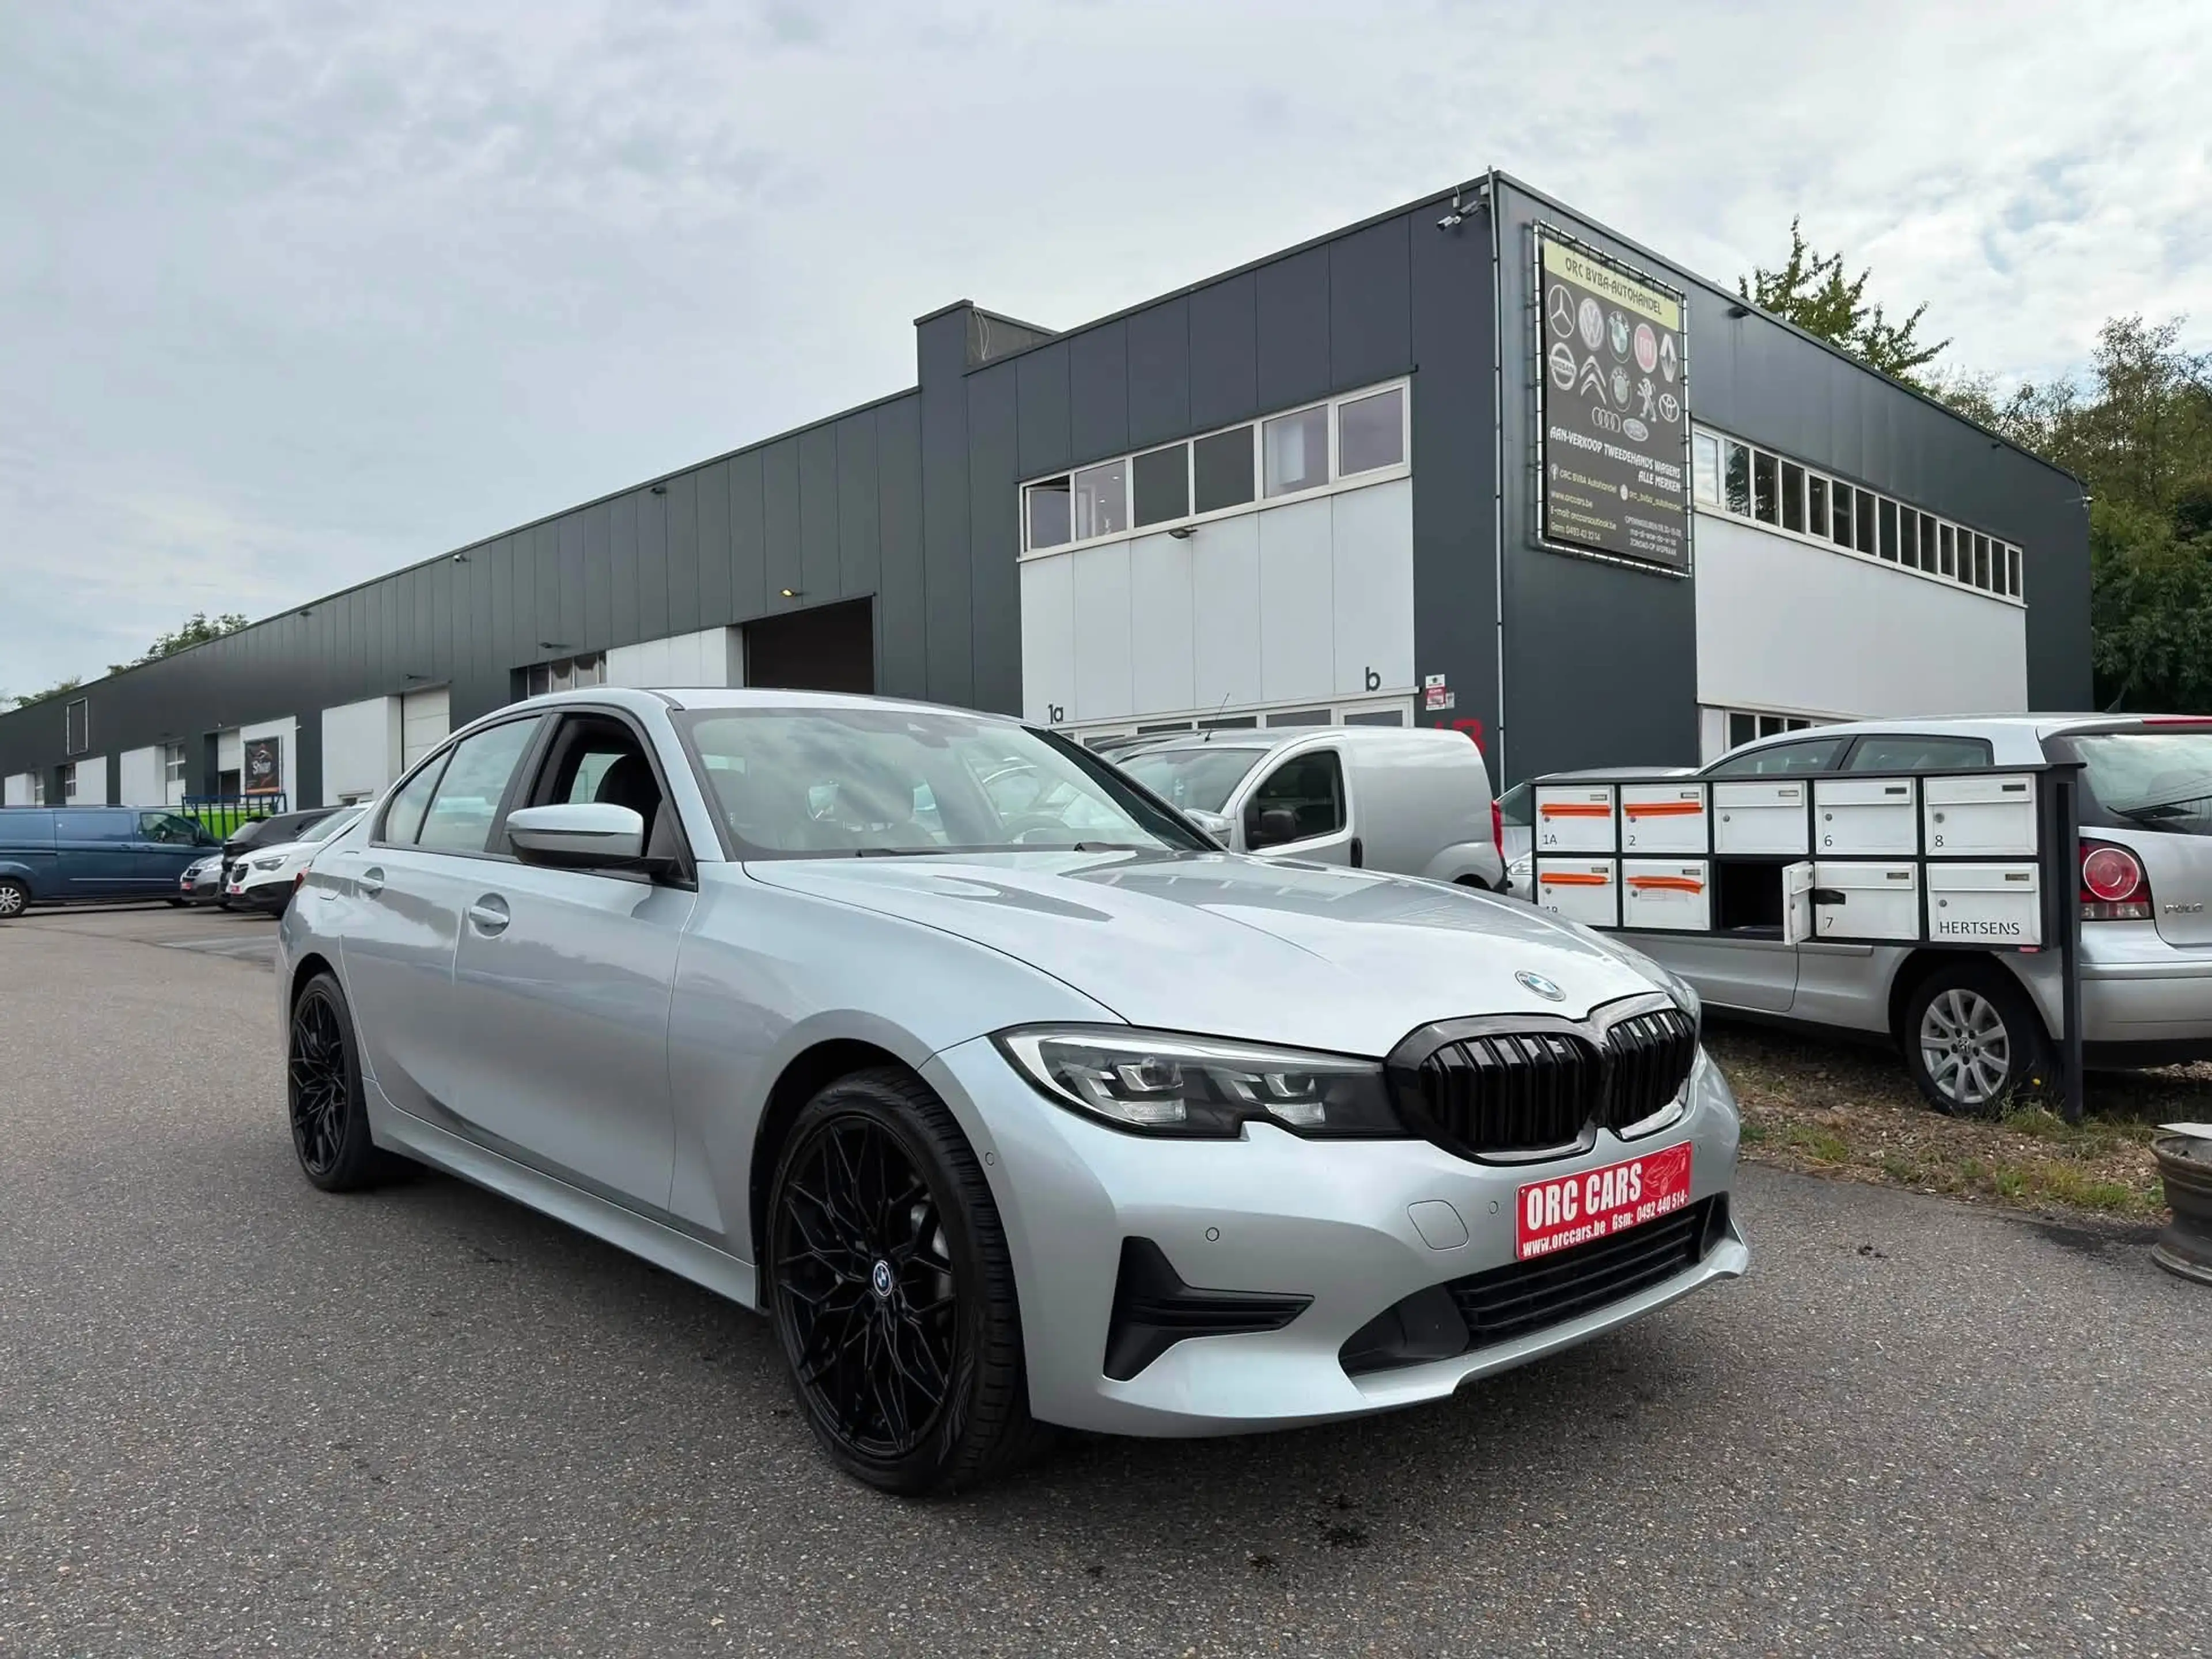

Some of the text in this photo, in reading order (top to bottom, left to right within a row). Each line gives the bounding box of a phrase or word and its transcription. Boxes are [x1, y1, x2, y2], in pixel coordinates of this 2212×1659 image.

[1565, 257, 1662, 315] ORC BVBA-AUTOHANDEL
[1550, 426, 1681, 479] AAN-VERKOOP TWEEDEHANDS WAGENS
[1559, 469, 1572, 480] ORC
[1638, 470, 1681, 493] ALLE MERKEN
[1365, 666, 1381, 692] b
[1048, 704, 1063, 724] 1a
[1543, 834, 1558, 845] 1A
[1628, 835, 1636, 846] 2
[1824, 835, 1832, 847] 6
[1935, 835, 1944, 847] 8
[1825, 917, 1833, 929] 7
[1940, 922, 2020, 935] HERTSENS
[1527, 1162, 1642, 1230] ORC CARS
[1522, 1219, 1606, 1257] www.orccars.be
[1612, 1212, 1633, 1230] Gsm:
[1637, 1202, 1656, 1223] 0492
